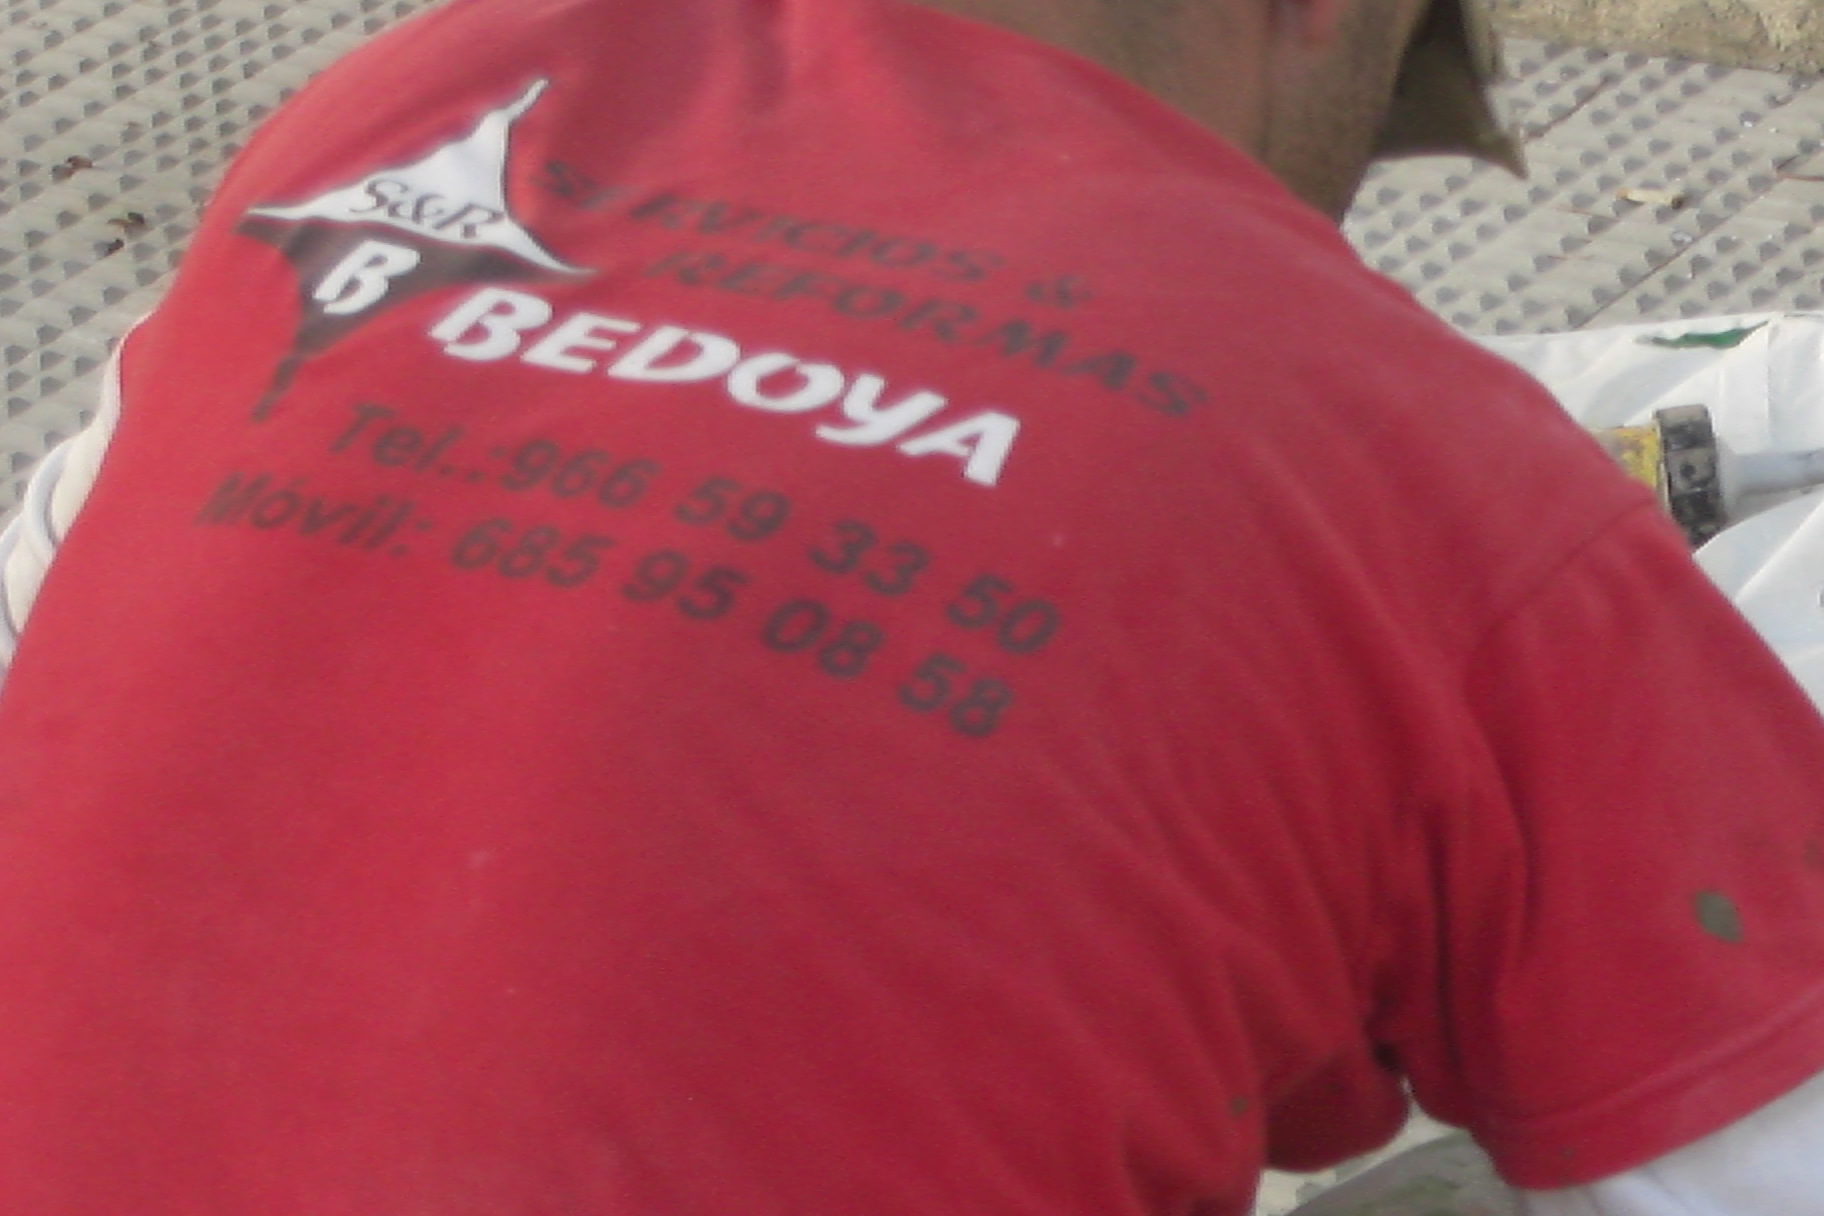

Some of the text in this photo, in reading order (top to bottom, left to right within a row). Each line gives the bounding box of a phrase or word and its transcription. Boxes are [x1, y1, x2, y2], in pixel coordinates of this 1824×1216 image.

[311, 239, 421, 315] B
[350, 178, 505, 240] S&R
[428, 286, 1023, 487] BEDOYA
[643, 250, 1208, 418] REFORMAS
[448, 516, 617, 589] 685
[618, 549, 752, 622] 95
[760, 599, 884, 679] 08
[896, 653, 1014, 738] 58
[672, 476, 792, 543] 59
[808, 518, 931, 597] 33
[944, 573, 1060, 656] 50
